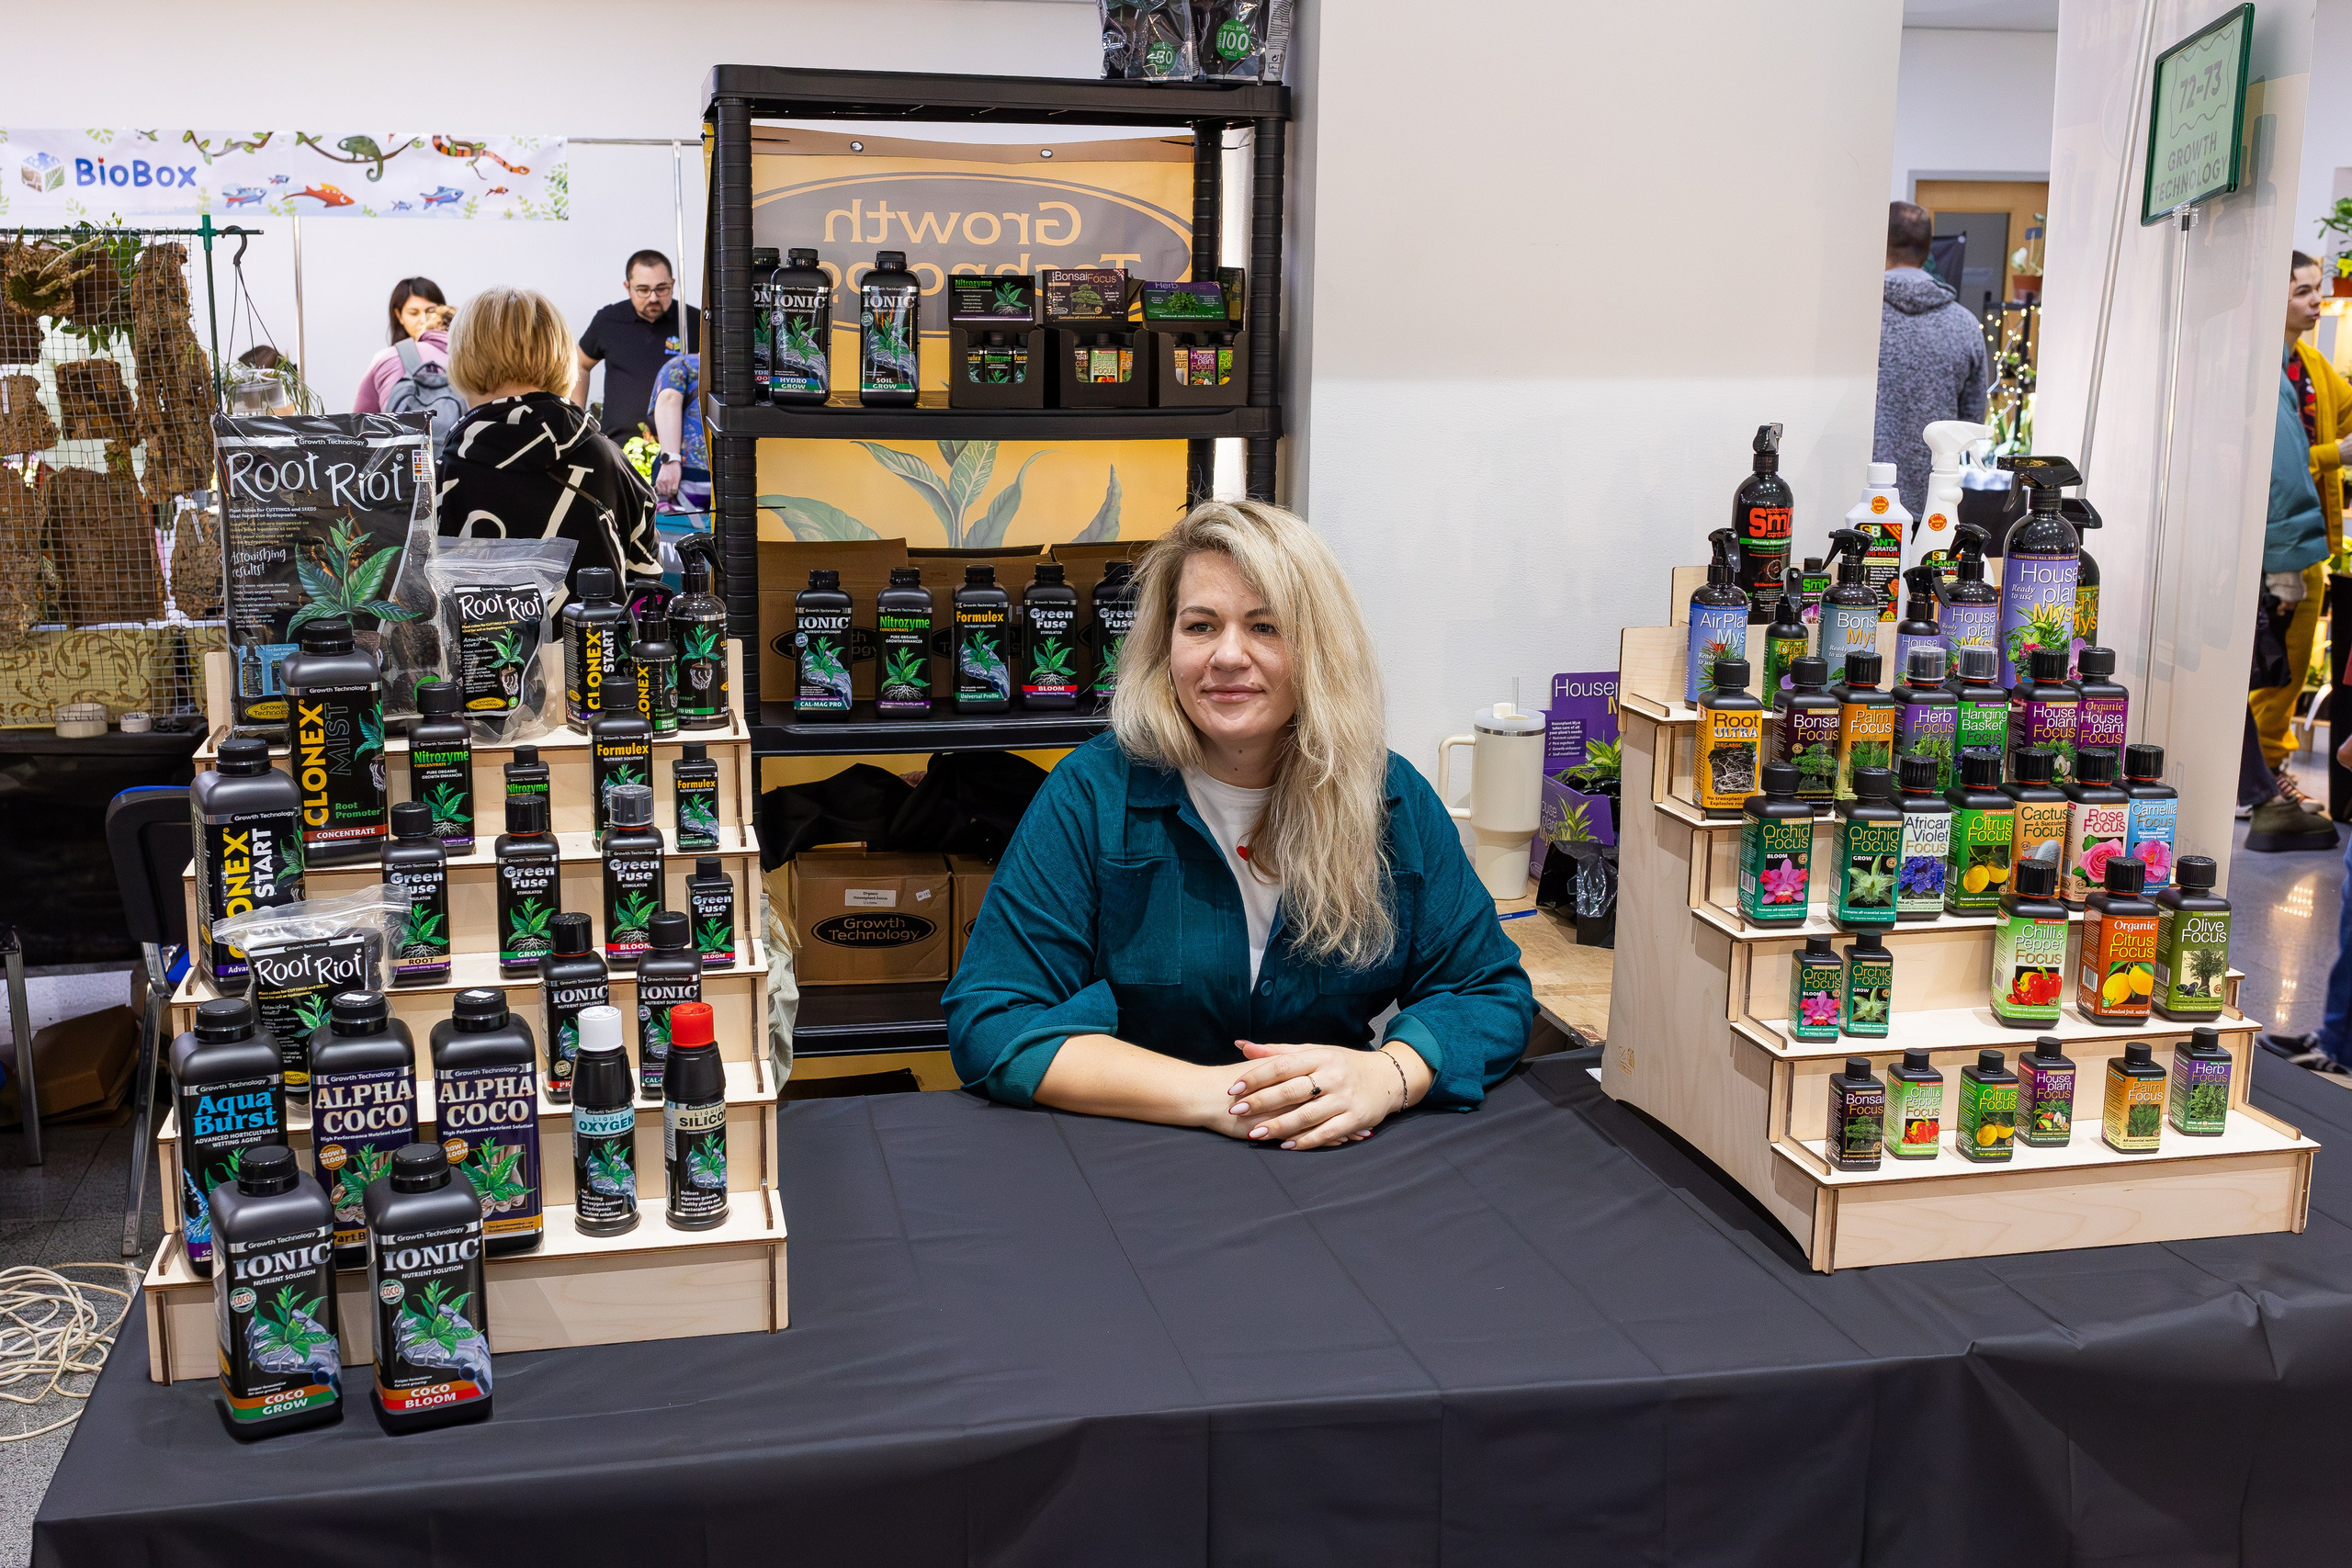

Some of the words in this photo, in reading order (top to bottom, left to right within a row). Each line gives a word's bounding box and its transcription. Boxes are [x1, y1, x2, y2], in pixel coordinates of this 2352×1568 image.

[1221, 30, 1249, 51] 100
[2179, 59, 2222, 113] 72-73
[2167, 131, 2217, 172] GROWTH
[75, 155, 197, 187] BioBox
[2154, 154, 2229, 205] TECHNOLOGY
[955, 279, 992, 288] Nitrozyme
[774, 295, 826, 308] IONIC
[863, 295, 915, 308] IONIC
[226, 451, 320, 502] Root
[324, 462, 404, 512] Riot
[2021, 562, 2077, 583] House
[2011, 584, 2036, 594] Ready
[459, 595, 505, 621] Root
[506, 592, 543, 621] Riot
[956, 611, 1003, 622] Formulex
[1030, 608, 1073, 618] Green
[1952, 609, 1996, 623] House
[797, 617, 850, 628] IONIC
[880, 616, 930, 632] Nitrozyme
[1036, 619, 1067, 628] Fuse
[603, 629, 614, 673] START
[1699, 652, 1716, 660] Ready
[586, 629, 603, 711] CLONEX
[2033, 705, 2075, 718] House
[2086, 702, 2124, 713] Organic
[1713, 713, 1758, 728] Root
[1857, 711, 1889, 723] Palm
[1919, 710, 1951, 723] Herb
[1961, 708, 2007, 721] Hanging
[2081, 712, 2122, 724] House
[1794, 715, 1839, 728] Bonsai
[1851, 721, 1892, 734] Focus
[1914, 721, 1954, 734] Focus
[1962, 720, 2002, 730] Basket
[2047, 716, 2076, 728] plant
[1713, 728, 1758, 739] ULTRA
[1798, 728, 1838, 740] Focus
[2034, 725, 2075, 738] Focus
[2093, 722, 2123, 734] plant
[324, 703, 351, 776] MIST
[1966, 732, 2002, 742] Focus
[2081, 731, 2122, 743] Focus
[597, 743, 649, 756] Formulex
[414, 750, 469, 765] Nitrozyme
[298, 703, 329, 827] CLONEX
[507, 784, 548, 795] Nitrozyme
[678, 780, 716, 788] Formulex
[335, 802, 357, 810] Root
[2132, 804, 2177, 816] Camellia
[260, 810, 294, 819] Technology
[336, 808, 381, 818] Promoter
[2021, 807, 2067, 821] Cactus
[2088, 809, 2123, 822] Rose
[1904, 817, 1950, 829] African
[1972, 817, 2012, 830] Citrus
[2084, 819, 2125, 833] Focus
[2136, 817, 2174, 827] Focus
[317, 828, 376, 840] CONCENTRATE
[1763, 825, 1810, 839] Orchid
[1849, 827, 1899, 840] Orchid
[1914, 829, 1948, 842] Violet
[1968, 829, 2011, 841] Focus
[2024, 824, 2064, 838] Focus
[1765, 837, 1809, 849] Focus
[1851, 840, 1897, 852] Focus
[1905, 840, 1946, 852] Focus
[252, 829, 275, 898] START
[609, 859, 660, 871] Green
[503, 866, 554, 878] Green
[617, 871, 653, 882] Fuse
[390, 873, 443, 885] Green
[512, 877, 548, 889] Fuse
[693, 896, 731, 905] Green
[698, 905, 726, 913] Fuse
[843, 919, 905, 929] Growth
[2114, 920, 2155, 931] Organic
[2188, 919, 2224, 932] Olive
[829, 930, 920, 941] Technology
[2022, 925, 2055, 940] Chilli
[2182, 930, 2226, 943] Focus
[2015, 936, 2064, 951] Pepper
[2113, 933, 2154, 947] Citrus
[2015, 948, 2062, 964] Focus
[2109, 944, 2154, 958] Focus
[255, 954, 311, 986] Root
[314, 952, 361, 988] Riot
[1803, 969, 1842, 981] Orchid
[1853, 965, 1892, 977] Orchid
[1805, 978, 1841, 989] Focus
[1855, 976, 1891, 986] Focus
[552, 986, 608, 1003] IONIC
[640, 986, 697, 998] IONIC
[2196, 1064, 2224, 1075] Herb
[2037, 1073, 2070, 1084] House
[2192, 1072, 2228, 1082] Focus
[199, 1084, 227, 1092] Growth
[229, 1078, 266, 1089] Technology
[438, 1076, 535, 1103] ALPHA
[2047, 1081, 2072, 1091] plant
[2133, 1082, 2161, 1093] Palm
[315, 1079, 413, 1109] ALPHA
[1910, 1088, 1935, 1098] Chilli
[1983, 1089, 2018, 1101] Citrus
[2037, 1089, 2070, 1100] Focus
[2128, 1091, 2163, 1102] Focus
[195, 1090, 273, 1116] Aqua
[1846, 1094, 1884, 1105] Bonsai
[1905, 1097, 1940, 1108] Pepper
[1979, 1099, 2017, 1111] Focus
[447, 1100, 528, 1127] COCO
[1849, 1104, 1883, 1115] Focus
[1905, 1107, 1939, 1117] Focus
[193, 1107, 278, 1136] Burst
[323, 1104, 407, 1134] COCO
[579, 1114, 634, 1132] OXYGEN
[195, 1134, 229, 1145] ADVANCED
[230, 1128, 278, 1139] HORTICULTURAL
[391, 1127, 413, 1135] Solution
[211, 1139, 239, 1147] WETTING
[241, 1136, 262, 1145] AGENT
[233, 1242, 331, 1280] IONIC
[383, 1238, 481, 1272] IONIC
[254, 1275, 283, 1286] NUTRIENT
[285, 1269, 316, 1280] SOLUTION
[401, 1269, 432, 1280] NUTRIENT
[434, 1265, 463, 1275] SOLUTION
[411, 1384, 450, 1397] COCO
[265, 1390, 305, 1405] COCO
[405, 1393, 456, 1408] BLOOM
[262, 1398, 309, 1416] GROW
